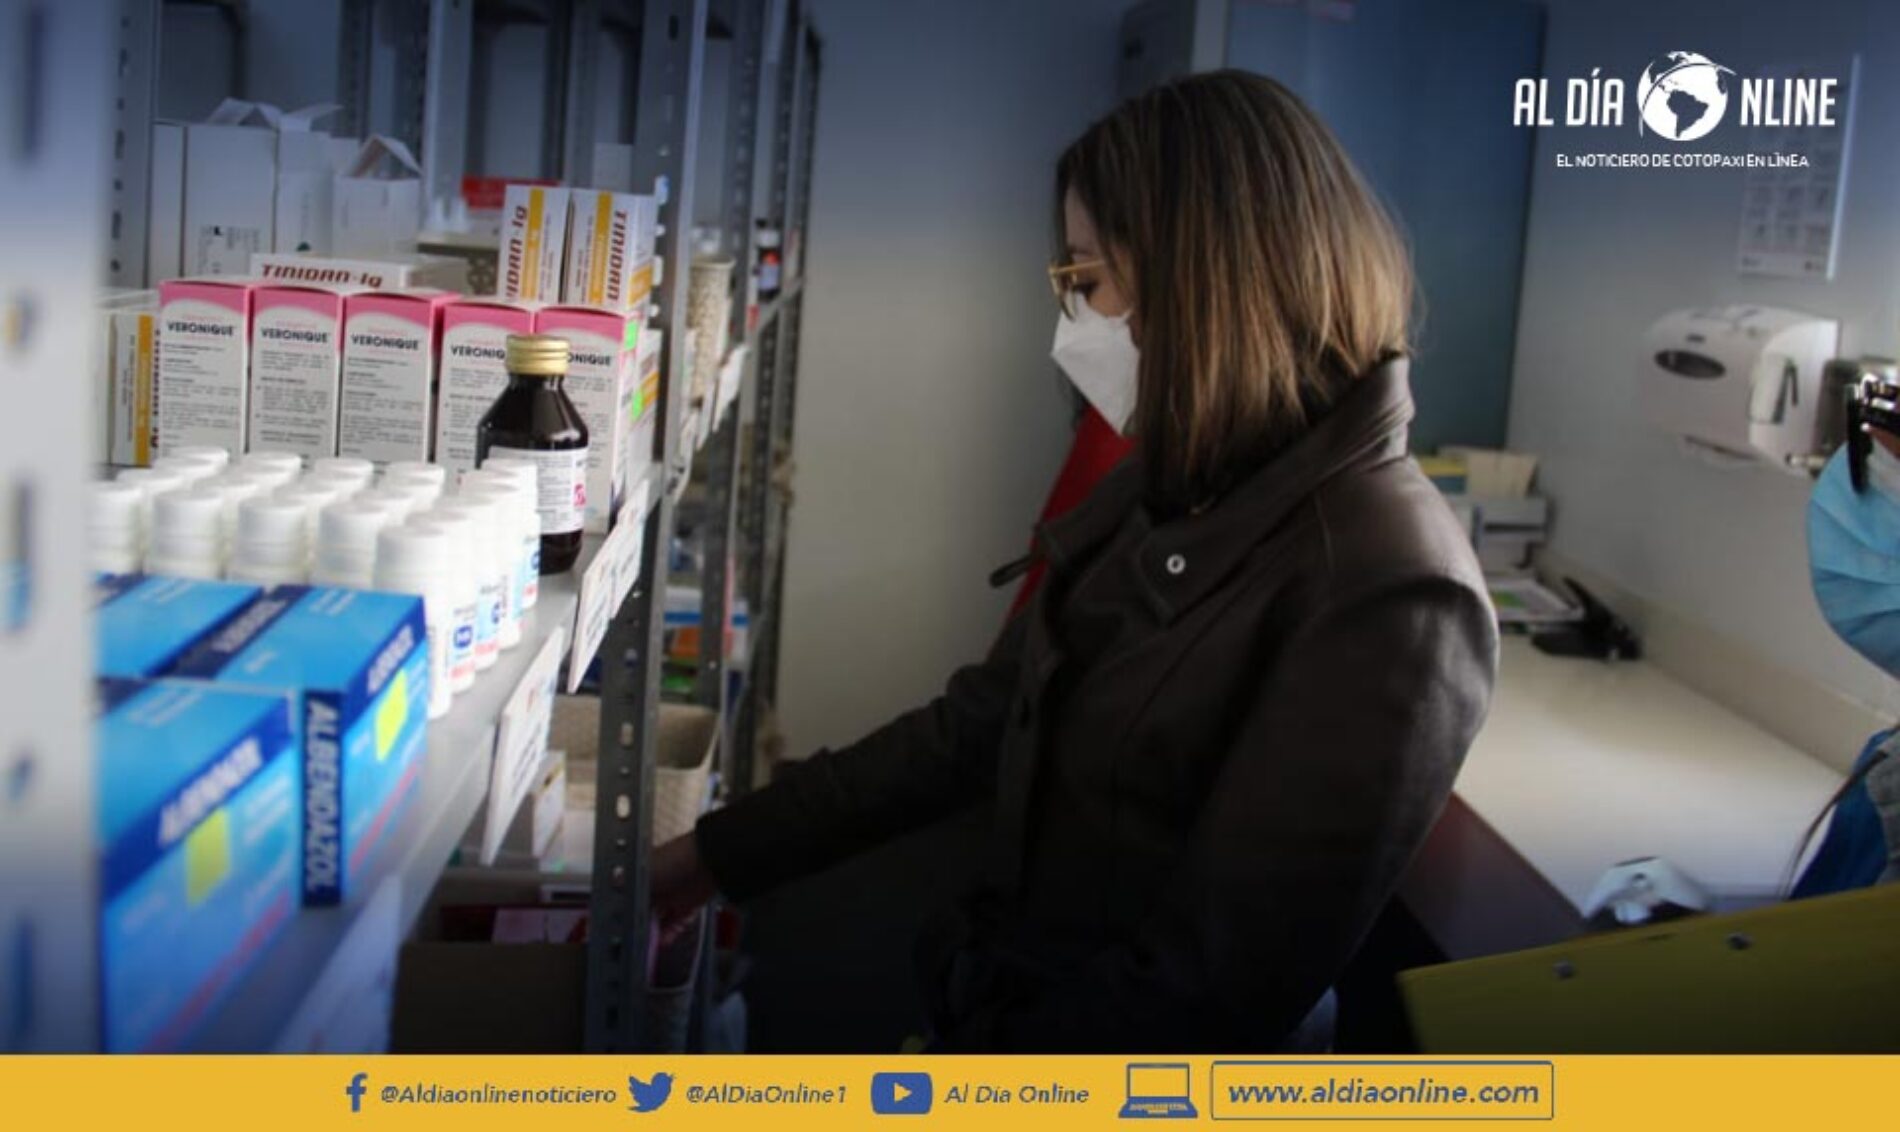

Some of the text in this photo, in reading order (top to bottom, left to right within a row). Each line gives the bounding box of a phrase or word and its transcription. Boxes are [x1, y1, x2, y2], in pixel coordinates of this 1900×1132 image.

[607, 210, 628, 300] TINIDAN
[167, 320, 235, 337] VERONIQUE
[260, 327, 329, 344] VERONIQUE
[350, 334, 420, 351] VERONIQUE
[450, 345, 505, 360] VERONIQ
[305, 700, 340, 893] ALBENDAZOL
